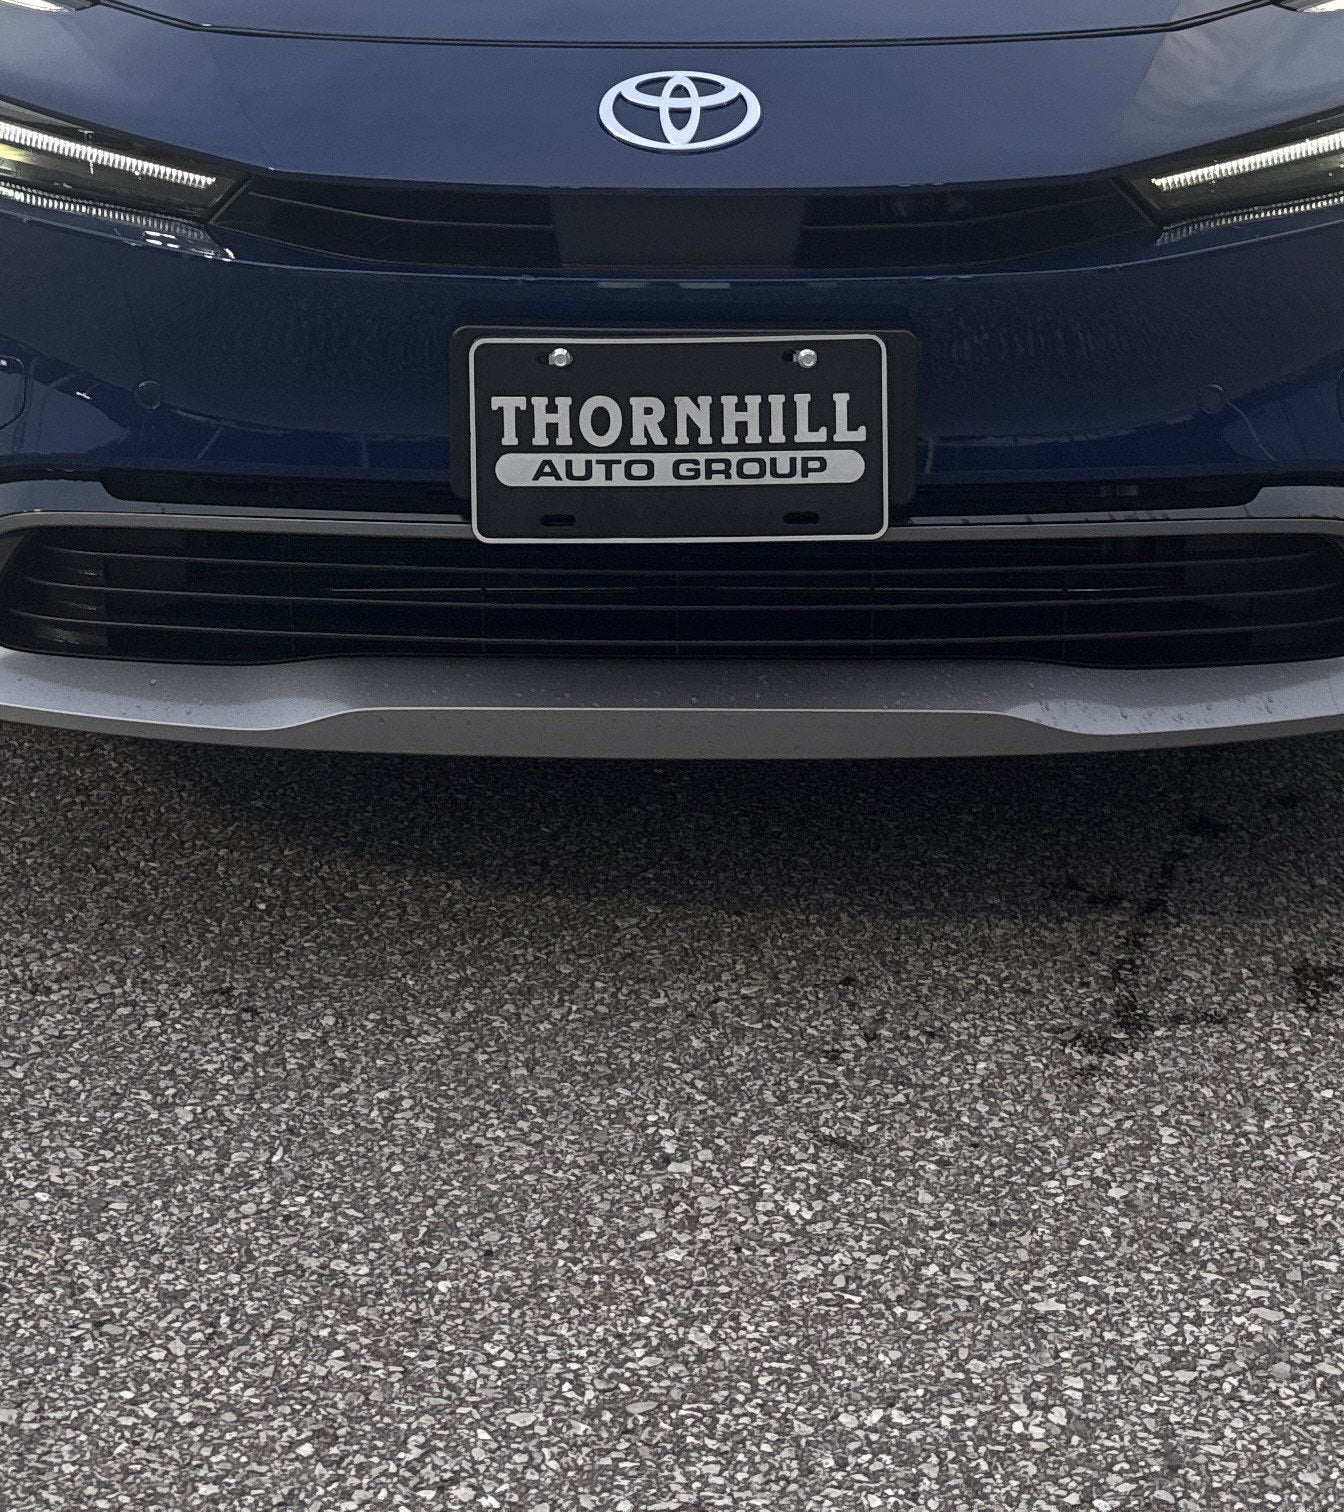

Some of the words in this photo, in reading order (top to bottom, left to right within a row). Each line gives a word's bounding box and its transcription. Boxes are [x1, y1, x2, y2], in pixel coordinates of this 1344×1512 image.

[490, 392, 867, 447] THORNHILL
[531, 459, 655, 482] AUTO
[671, 456, 828, 481] GROUP
